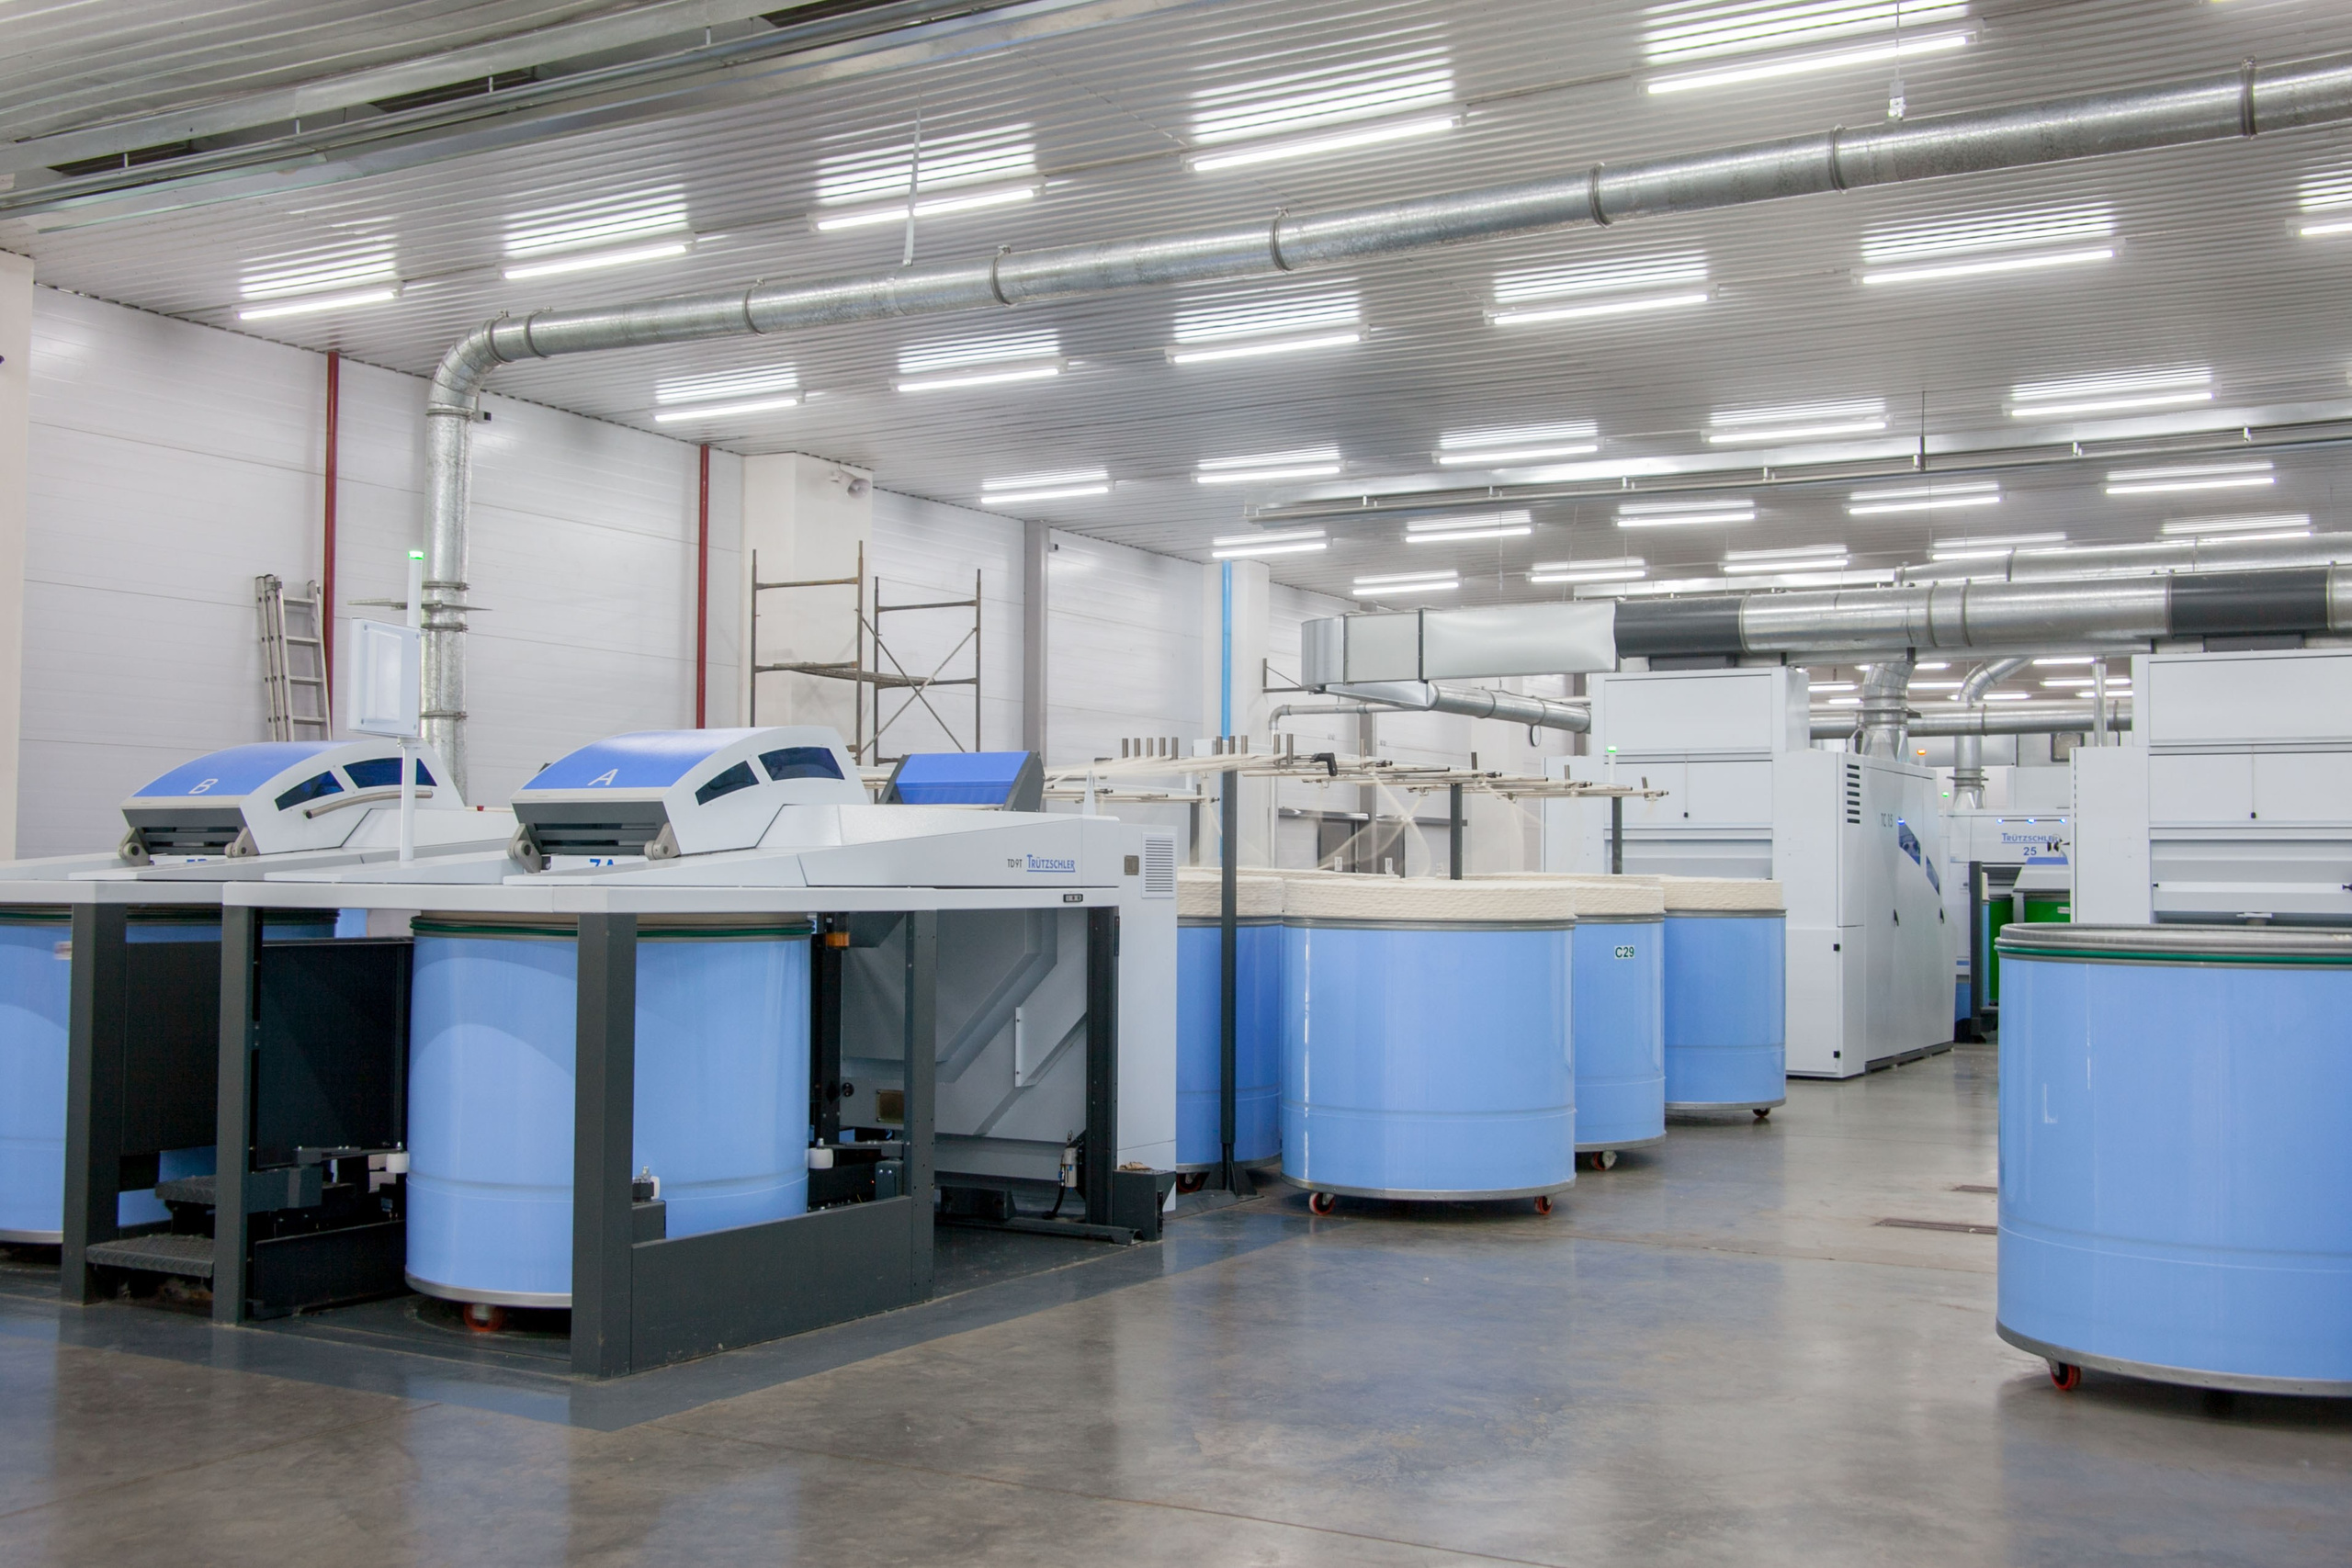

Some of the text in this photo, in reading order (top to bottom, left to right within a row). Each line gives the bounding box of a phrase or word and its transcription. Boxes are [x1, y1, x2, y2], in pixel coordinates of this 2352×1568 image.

[587, 768, 618, 786] A
[188, 779, 219, 795] B
[2023, 847, 2037, 855] 25
[1026, 854, 1075, 872] TRÜTZSCHLER
[1615, 947, 1634, 958] C29
